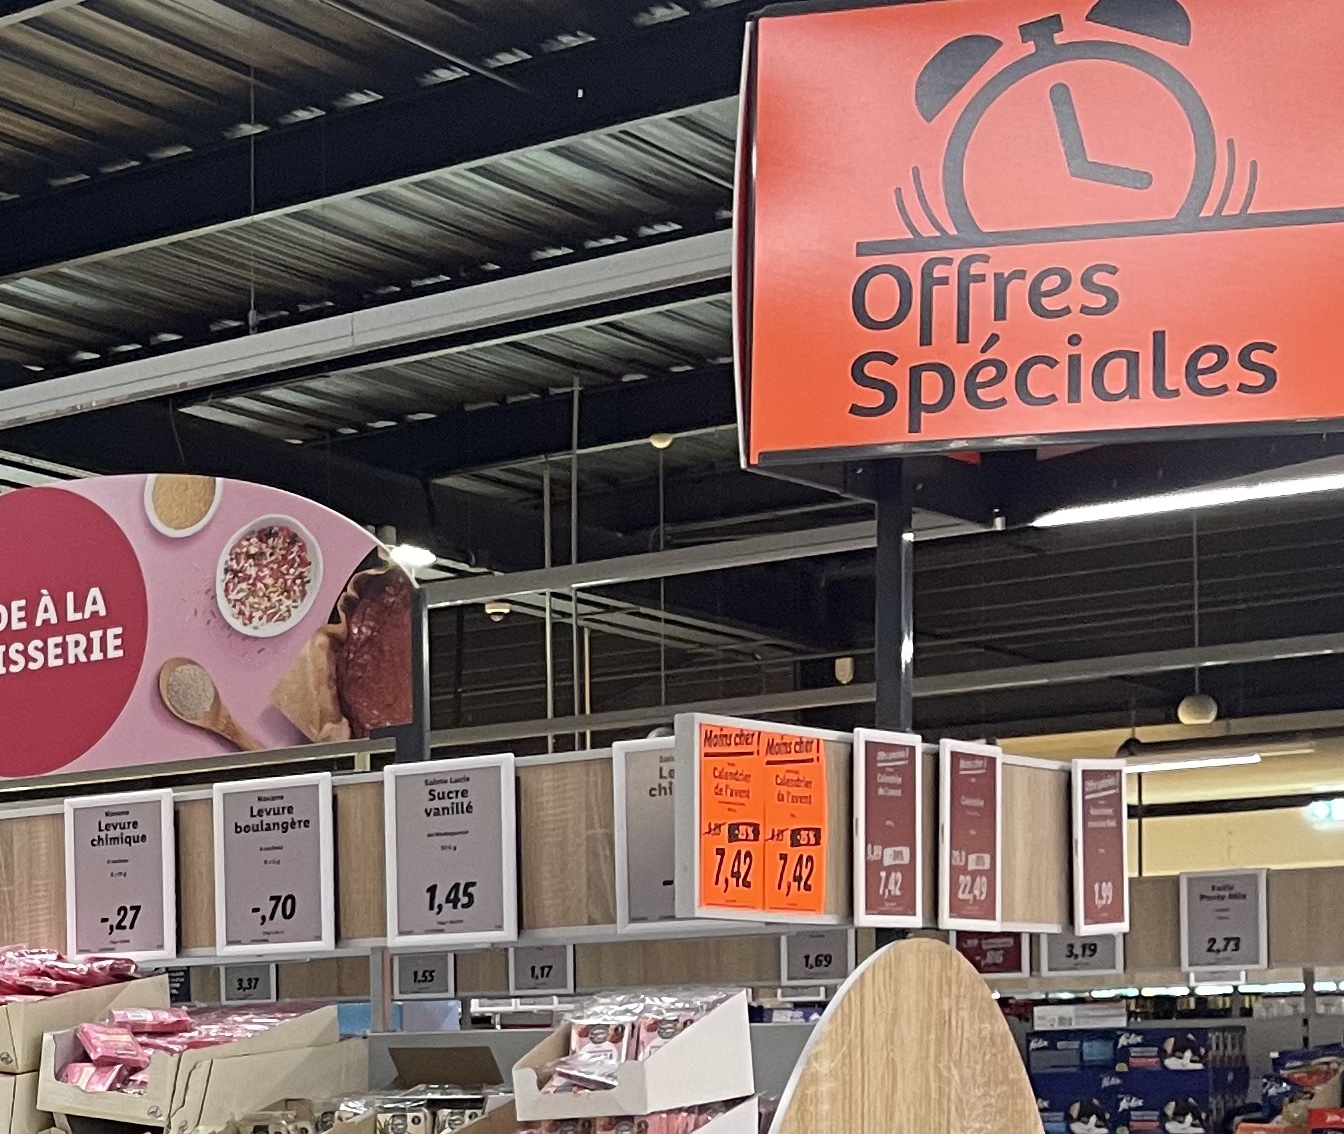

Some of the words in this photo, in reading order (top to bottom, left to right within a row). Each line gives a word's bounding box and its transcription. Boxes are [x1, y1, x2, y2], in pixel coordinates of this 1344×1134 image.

[851, 254, 1120, 347] Offres
[848, 330, 1278, 434] Spéciales
[35, 588, 61, 629] À
[67, 586, 108, 621] LA
[428, 787, 469, 802] Sucre
[249, 804, 294, 819] Levure
[424, 801, 474, 818] vanillé
[97, 819, 139, 833] Levure
[234, 817, 311, 835] boulangère
[90, 832, 147, 848] chimique
[714, 847, 753, 893] 7,42
[777, 853, 814, 897] 7,42
[425, 880, 477, 916] 1,45
[251, 893, 297, 926] -,70
[100, 904, 142, 936] -,27
[1065, 943, 1098, 959] 3,19
[1206, 937, 1241, 953] 2,73
[803, 953, 833, 969] 1,69
[236, 976, 260, 992] 3,37
